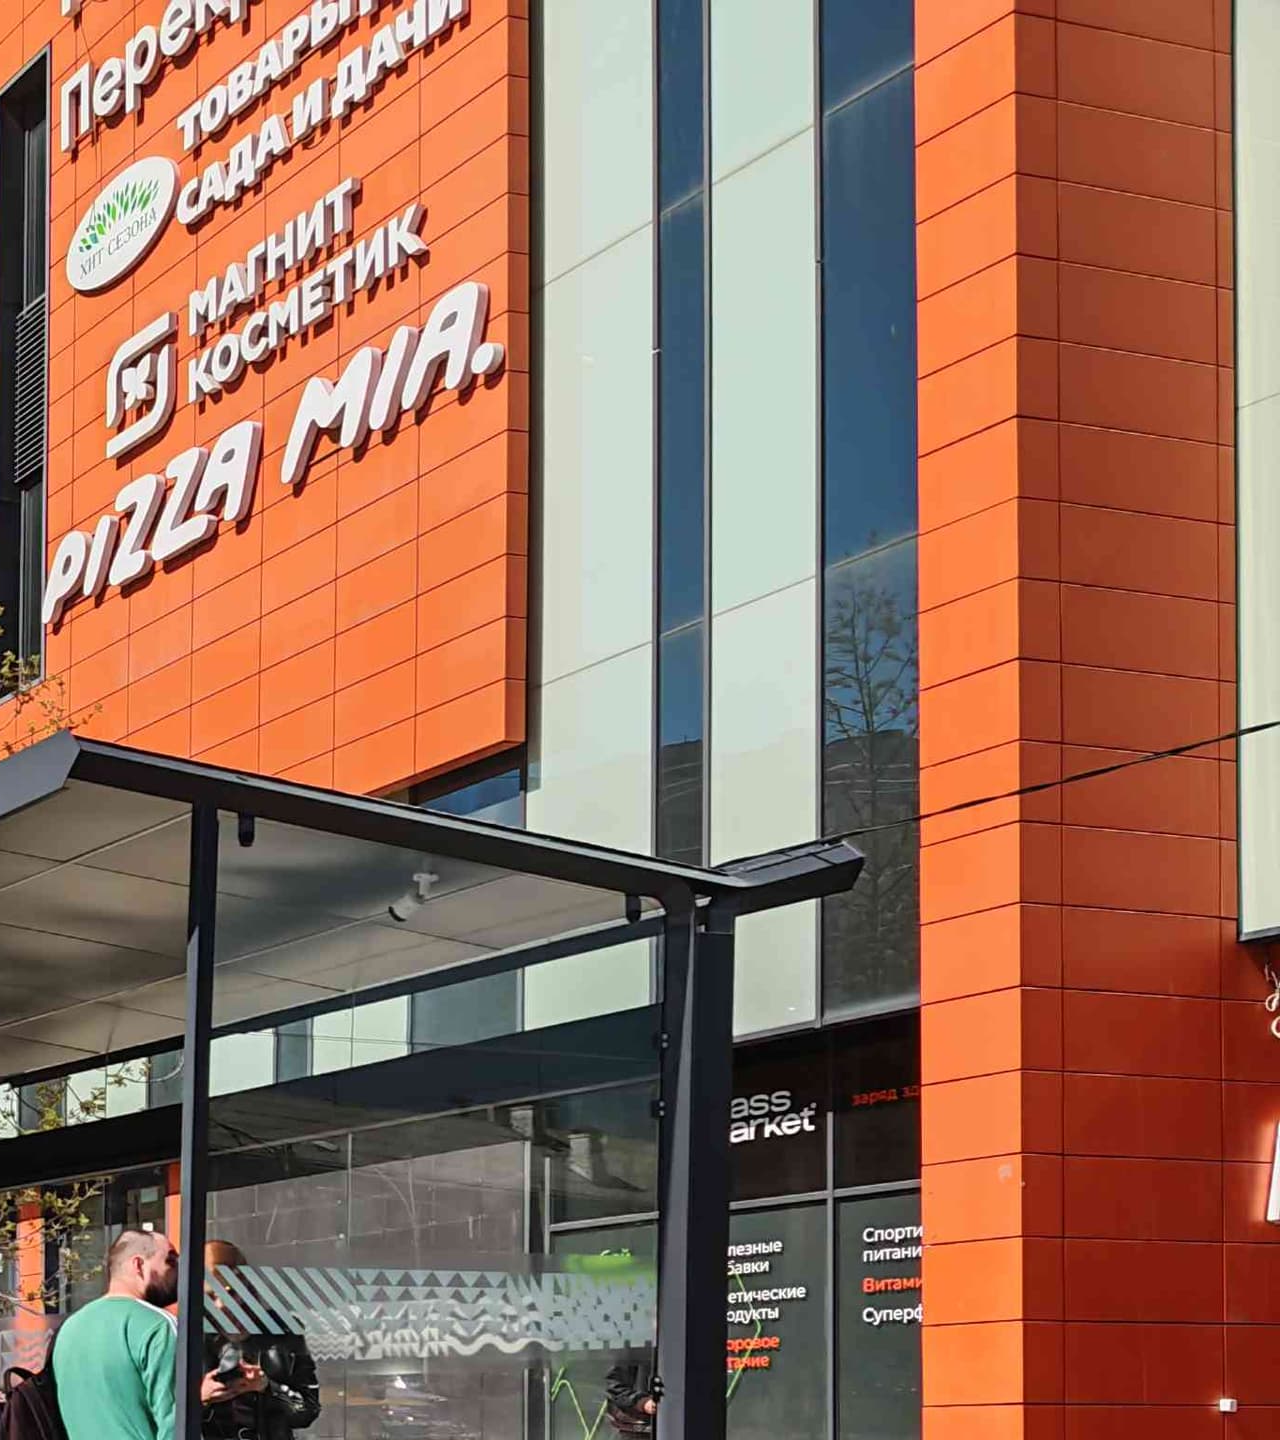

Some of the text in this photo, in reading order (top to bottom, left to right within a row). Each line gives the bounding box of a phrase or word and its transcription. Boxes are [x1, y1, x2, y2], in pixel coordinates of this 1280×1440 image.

[61, 0, 242, 153] Перек
[176, 0, 464, 224] САДА И ДАЧИ
[80, 207, 158, 280] ХИТ СЕЗОНА
[188, 203, 429, 405] КОСМЕТИК
[189, 177, 356, 337] МАГНИТ
[42, 420, 261, 625] PIZZA
[862, 1226, 923, 1243] Спорти
[862, 1245, 923, 1263] питани
